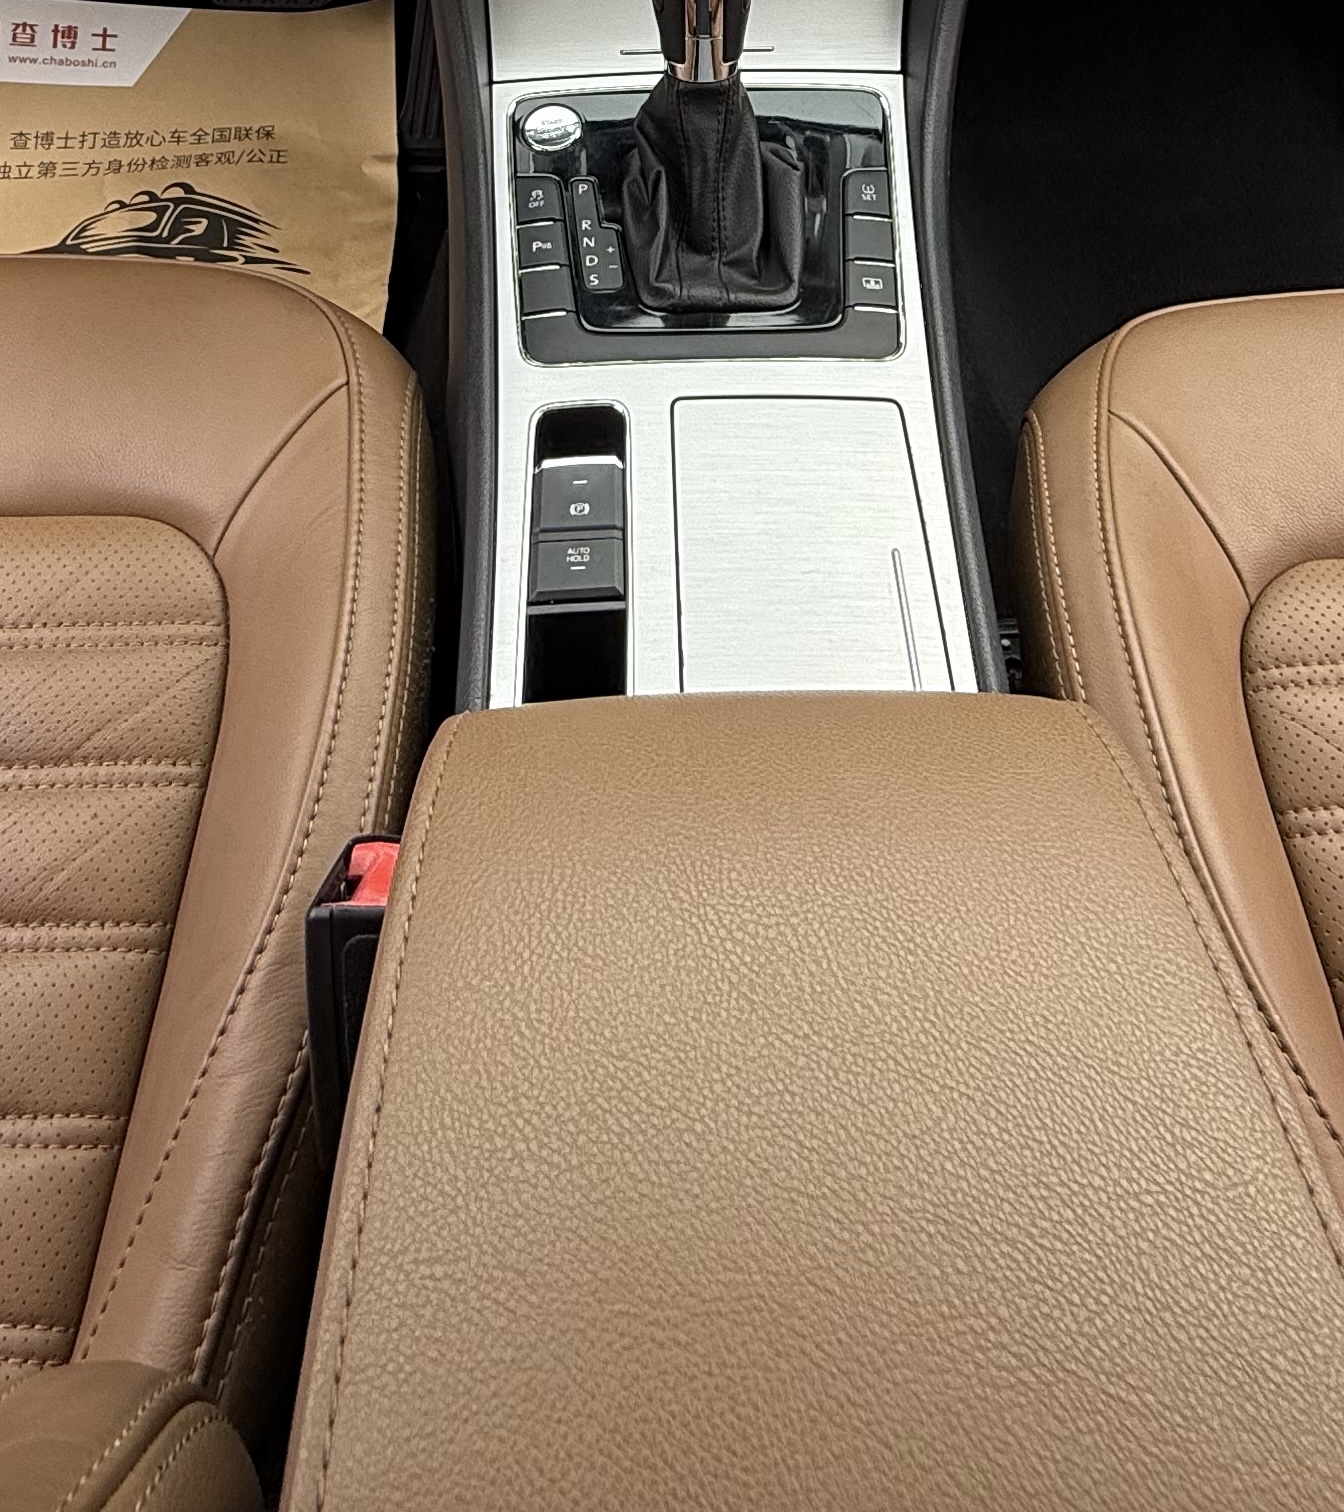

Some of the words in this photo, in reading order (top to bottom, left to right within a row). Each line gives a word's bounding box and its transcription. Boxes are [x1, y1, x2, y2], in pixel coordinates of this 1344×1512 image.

[9, 22, 118, 52] 查博士
[8, 55, 117, 69] www.chaboshi.cn
[9, 125, 276, 150] 查博士打造放心车全国联保
[578, 183, 588, 195] P
[528, 200, 545, 208] OFF
[581, 219, 592, 231] R
[582, 236, 595, 247] N
[585, 255, 598, 266] D
[589, 273, 599, 285] S
[566, 554, 590, 563] HOLD
